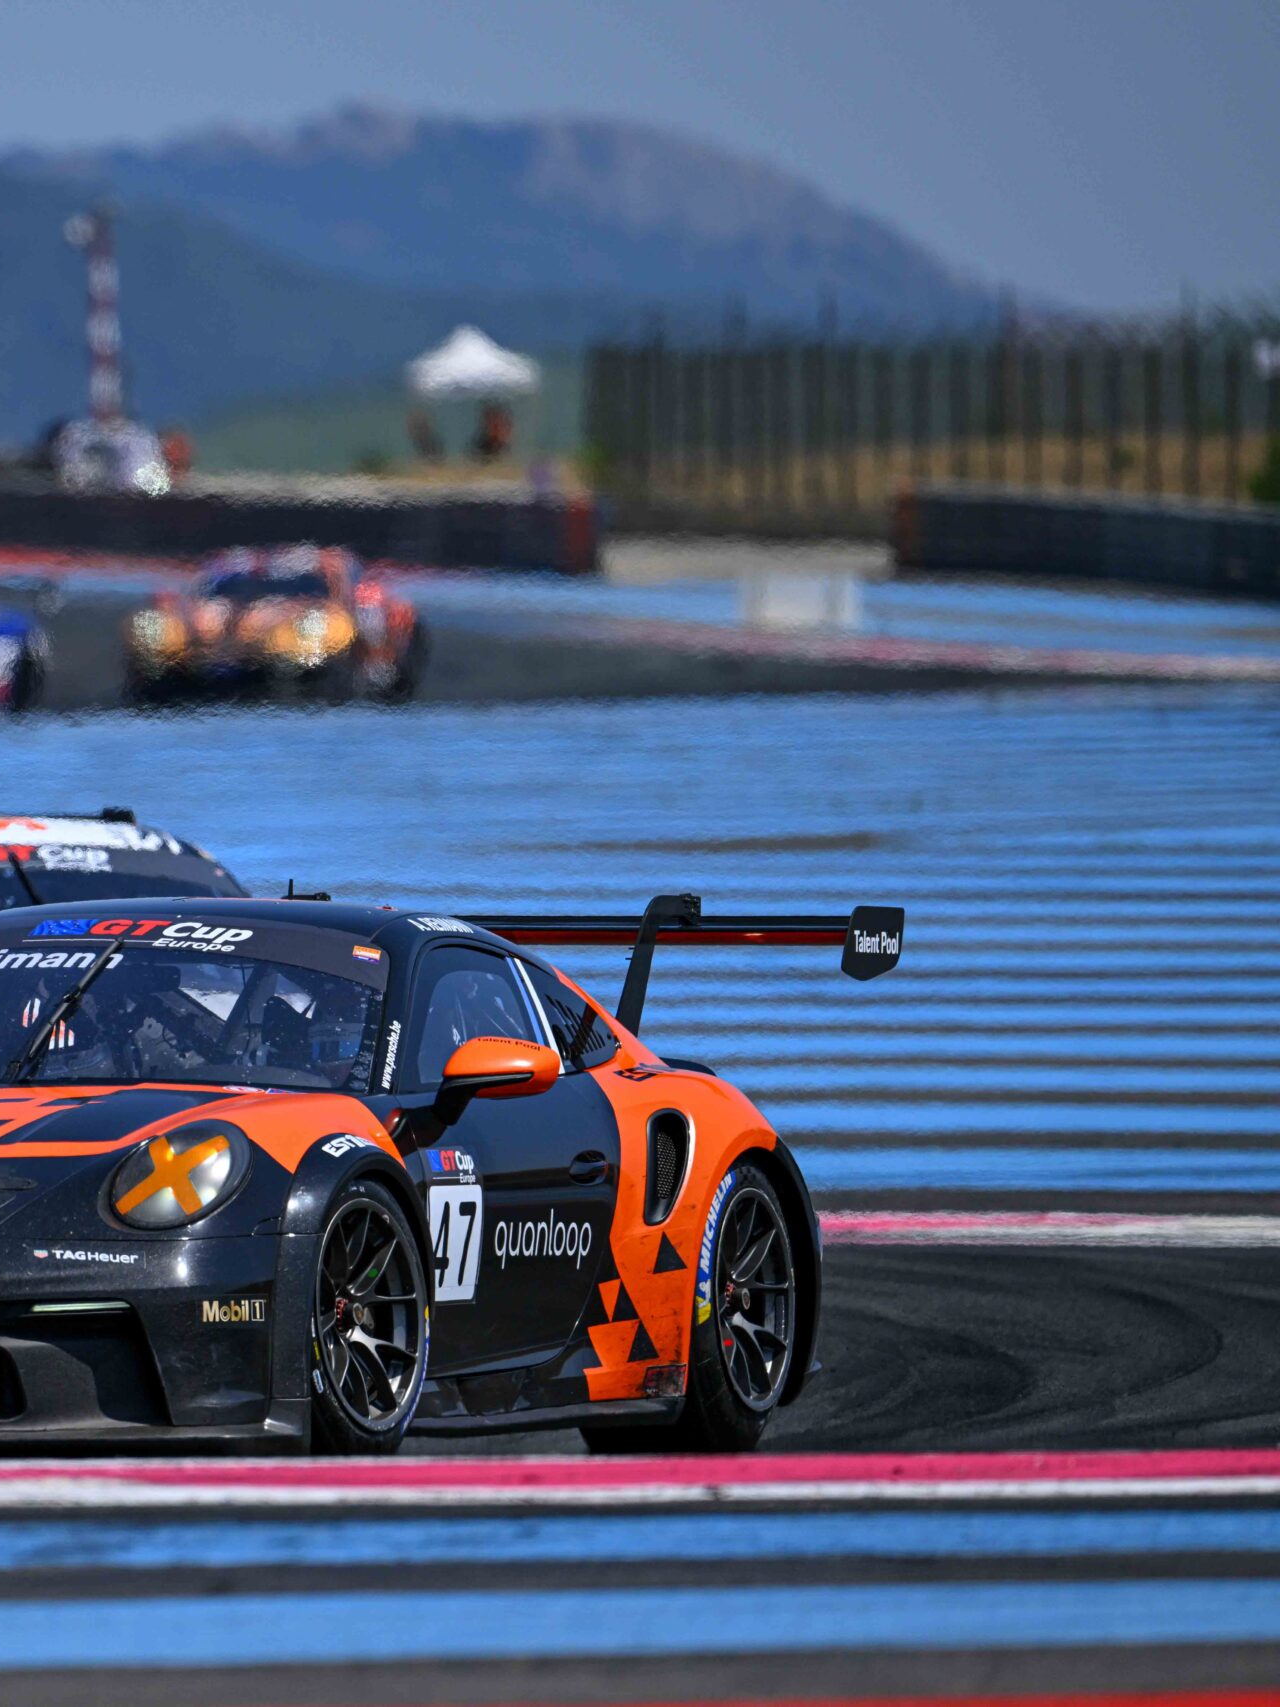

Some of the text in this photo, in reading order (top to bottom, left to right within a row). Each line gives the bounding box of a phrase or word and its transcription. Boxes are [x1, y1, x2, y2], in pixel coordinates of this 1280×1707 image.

[90, 919, 253, 944] GT Cup
[853, 929, 899, 955] Talent Pool
[152, 938, 236, 952] Europe
[440, 1151, 475, 1174] GT Cup
[459, 1173, 476, 1185] Europe
[700, 1172, 733, 1274] MICHELIN
[434, 1201, 477, 1289] 47
[494, 1208, 591, 1270] quanloop
[202, 1300, 250, 1323] Mobil
